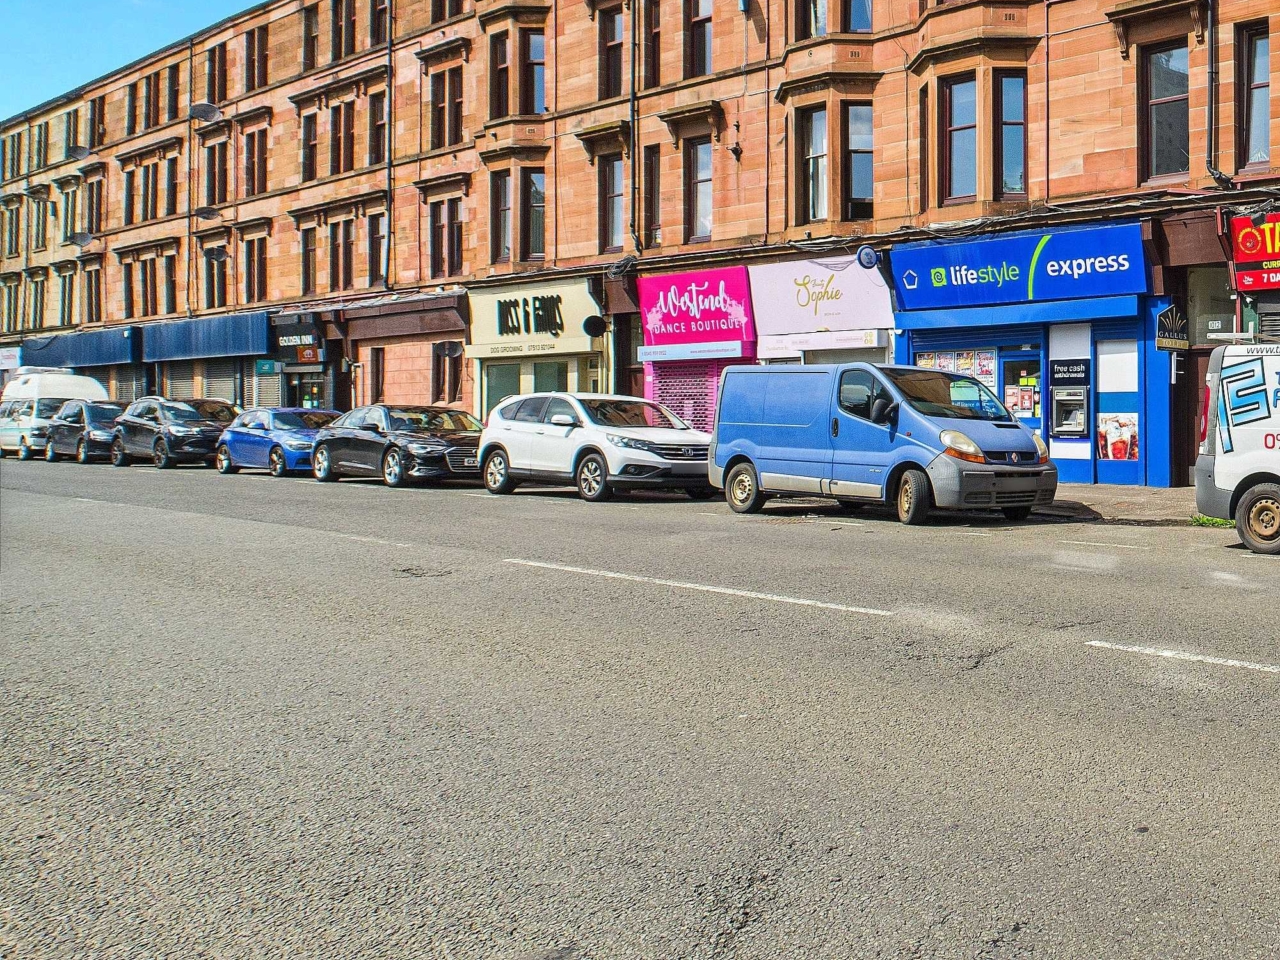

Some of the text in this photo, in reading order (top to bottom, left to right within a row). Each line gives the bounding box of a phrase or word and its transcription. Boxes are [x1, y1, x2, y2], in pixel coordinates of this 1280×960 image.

[950, 253, 1130, 288] lifestyle express
[1262, 273, 1268, 283] 7
[659, 280, 729, 320] Westend
[794, 273, 843, 317] Sophie
[654, 318, 741, 335] DANCE BOUTIQUE
[279, 334, 312, 346] GOLDEN INN
[1158, 330, 1188, 340] GALLUS
[1054, 363, 1086, 373] free cash
